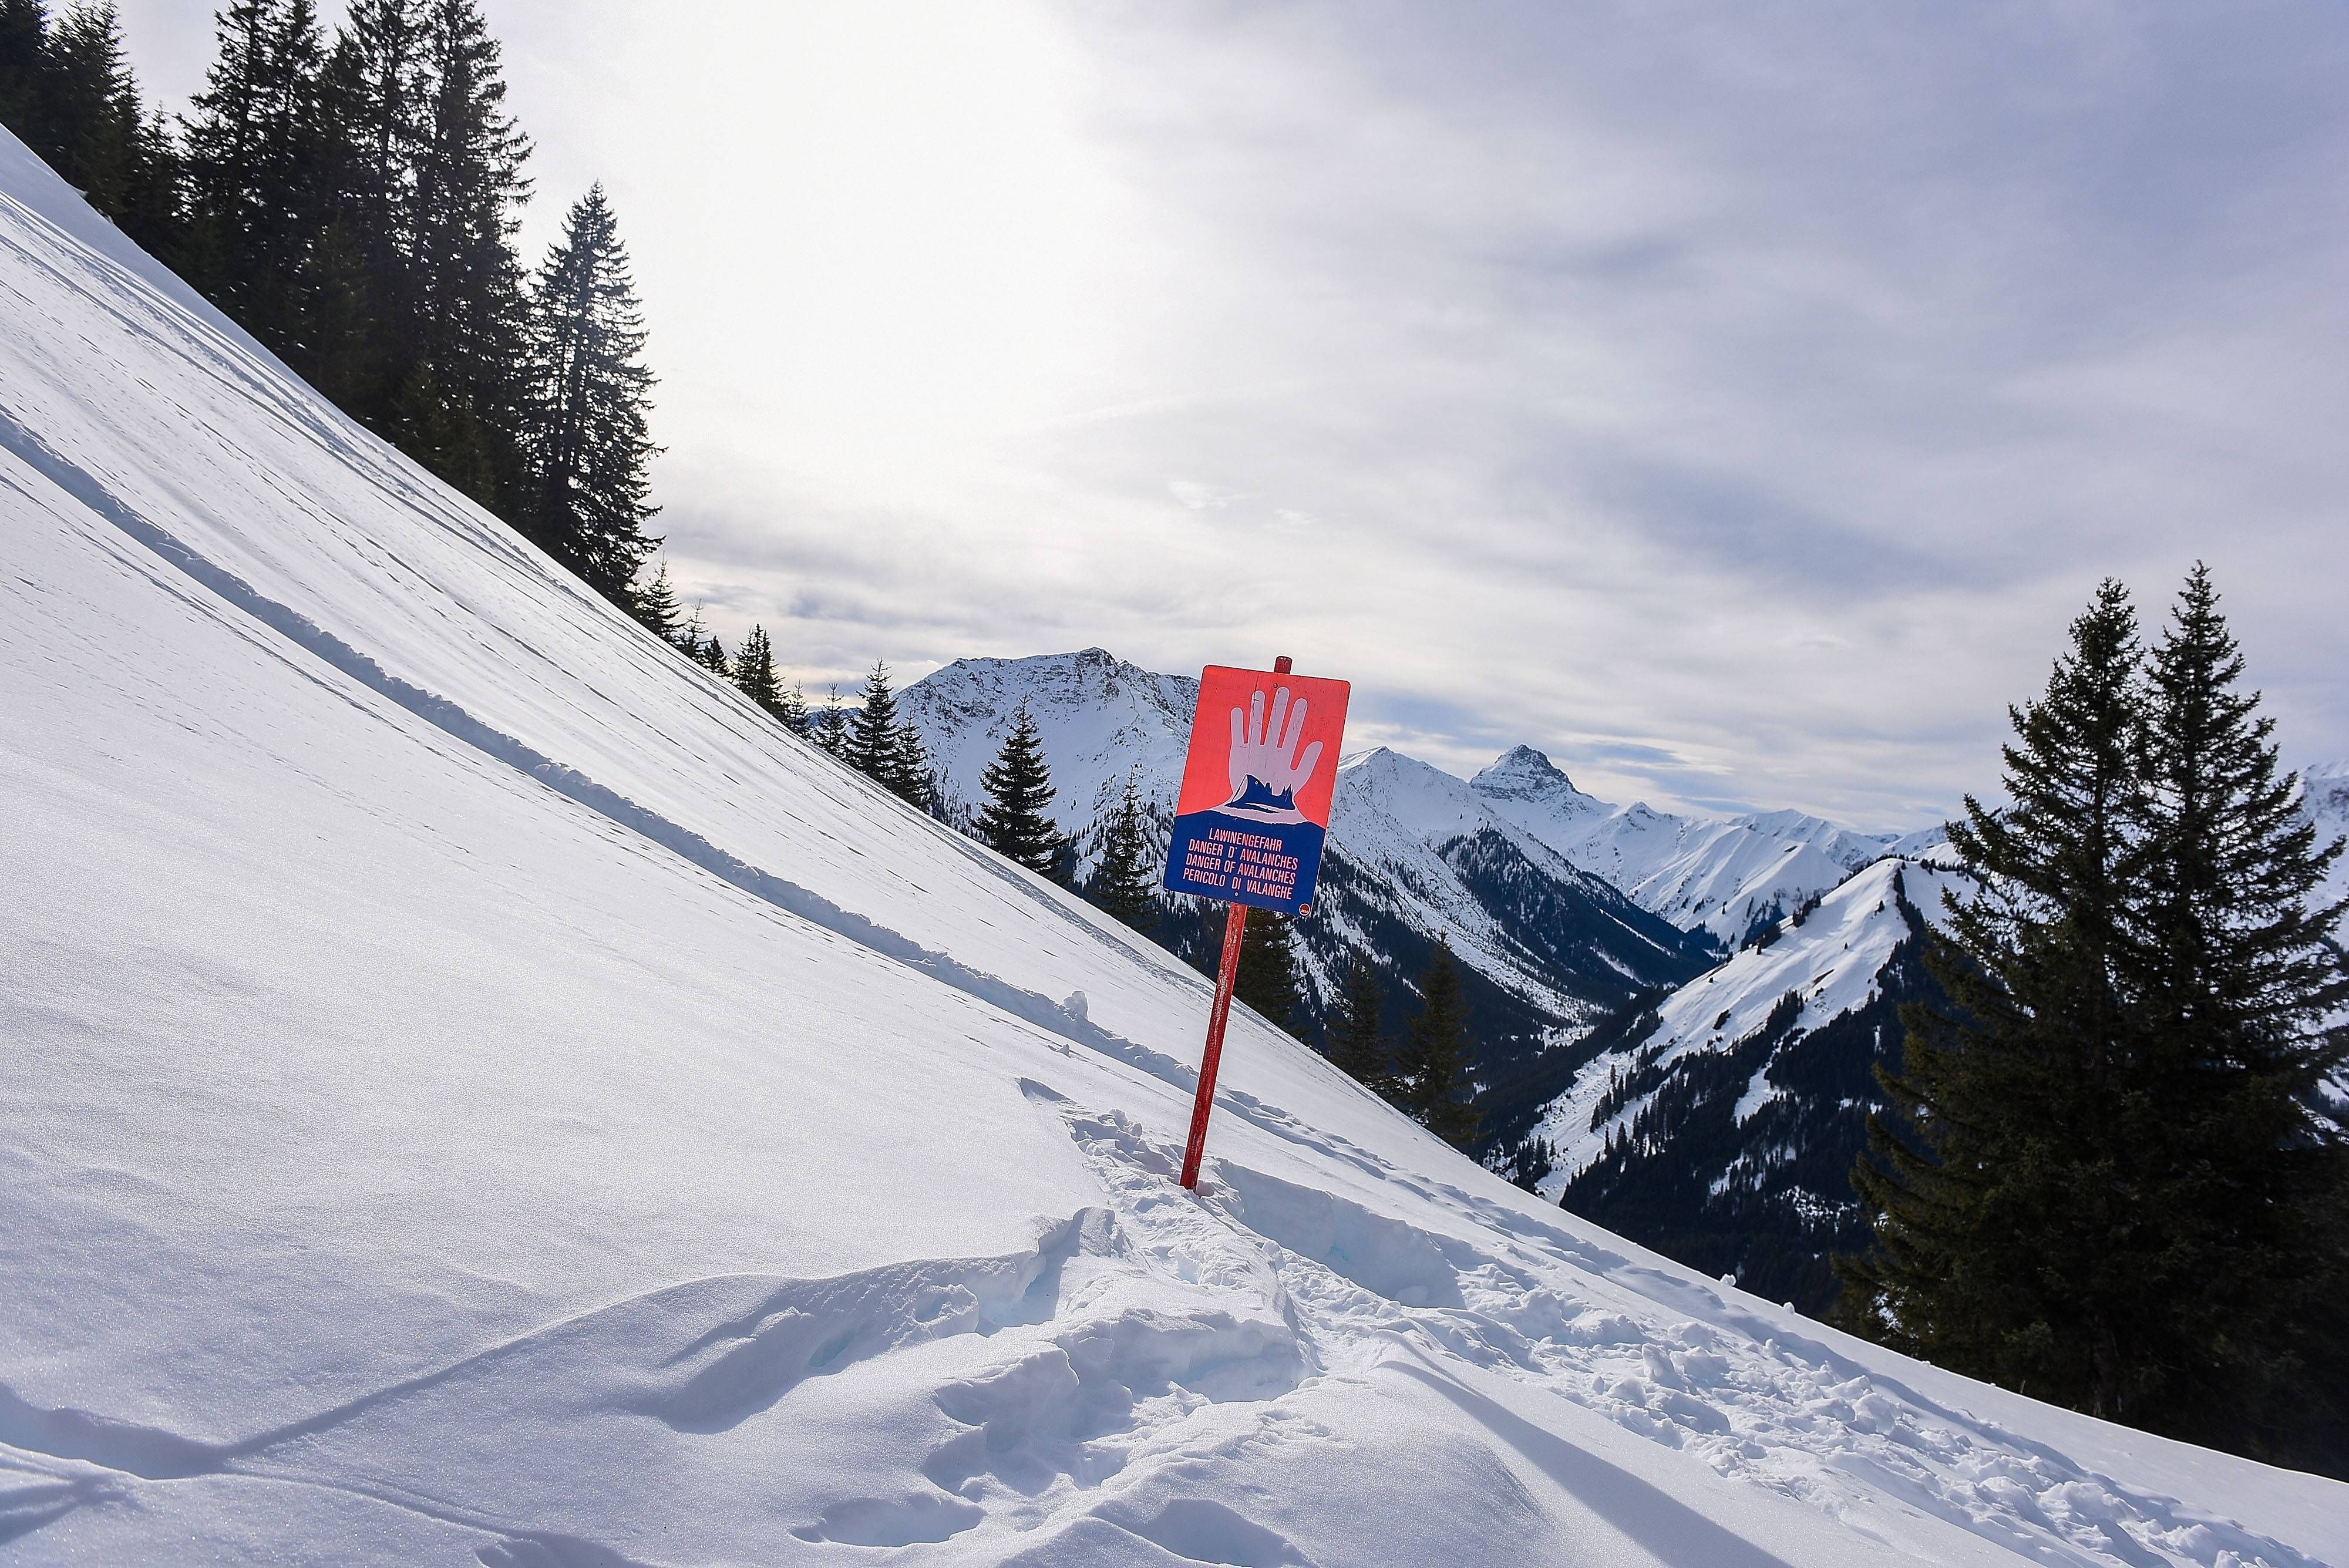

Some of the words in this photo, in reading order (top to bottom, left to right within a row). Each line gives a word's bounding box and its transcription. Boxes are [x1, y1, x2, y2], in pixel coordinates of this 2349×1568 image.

[1189, 839, 1223, 856] DANGER
[1240, 849, 1298, 870] AVALANCHES
[1209, 828, 1282, 852] LAWINENGEFAHR
[1183, 868, 1226, 887] PERICOLO
[1231, 877, 1241, 890] DI
[1247, 880, 1293, 900] VALANGHE
[1186, 853, 1221, 870] DANGER
[1224, 860, 1236, 873] OF
[1237, 863, 1295, 885] AVALANCHES
